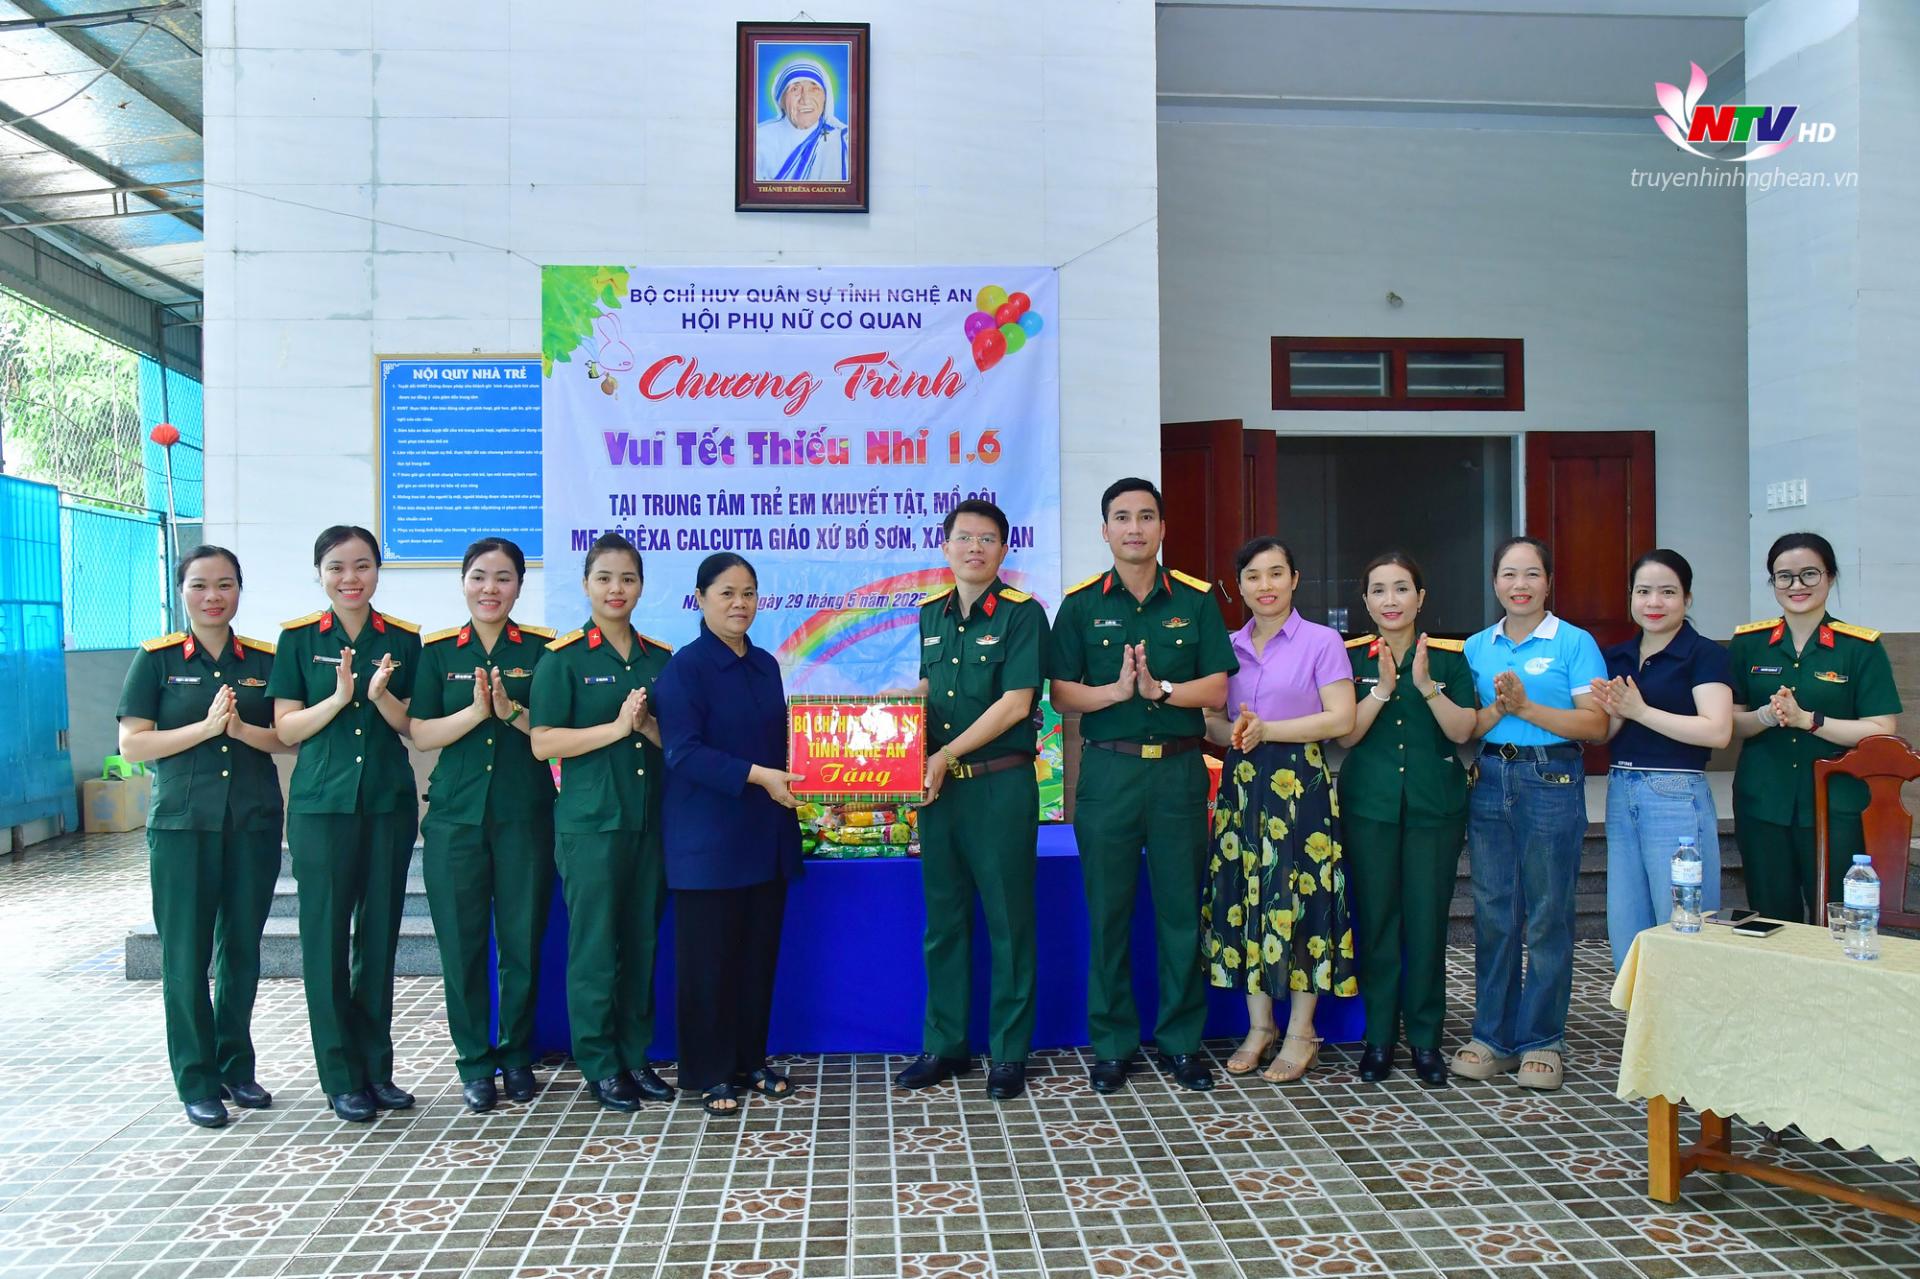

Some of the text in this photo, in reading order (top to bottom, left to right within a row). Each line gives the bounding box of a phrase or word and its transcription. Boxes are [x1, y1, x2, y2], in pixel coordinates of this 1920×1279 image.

[630, 282, 973, 306] BỘ CHỈ HUY QUÂN SỰ TỈNH NGHỆ AN
[682, 308, 922, 333] HỘI PHỤ NỮ CƠ QUAN
[413, 366, 527, 381] NỘI QUY NHÀ TRẺ
[638, 351, 967, 416] Chương Trình
[603, 425, 1002, 467] Vui Tết Thiếu Nhi 1.6
[609, 494, 638, 519] TẠI
[642, 494, 701, 515] TRUNG
[706, 488, 745, 515] TÂM
[750, 485, 783, 515] TRẺ
[788, 493, 815, 515] EM
[822, 485, 889, 515] KHUYẾT
[893, 487, 930, 518] TẬT,
[605, 524, 671, 550] RÊXA
[677, 529, 764, 551] CALCUTTA
[769, 523, 811, 551] GIÁO
[816, 520, 841, 551] XỨ
[846, 518, 870, 551] BỐ
[875, 527, 918, 554] SƠN,
[922, 523, 945, 548] XÃ
[1010, 526, 1033, 553] ẠN
[757, 594, 783, 610] gày
[785, 593, 803, 608] 29
[806, 593, 844, 609] tháng
[848, 593, 857, 608] 5
[860, 593, 890, 608] năm
[814, 714, 836, 733] CH
[808, 737, 840, 758] TỈNH
[886, 743, 906, 758] AN
[820, 763, 891, 787] Tặng
